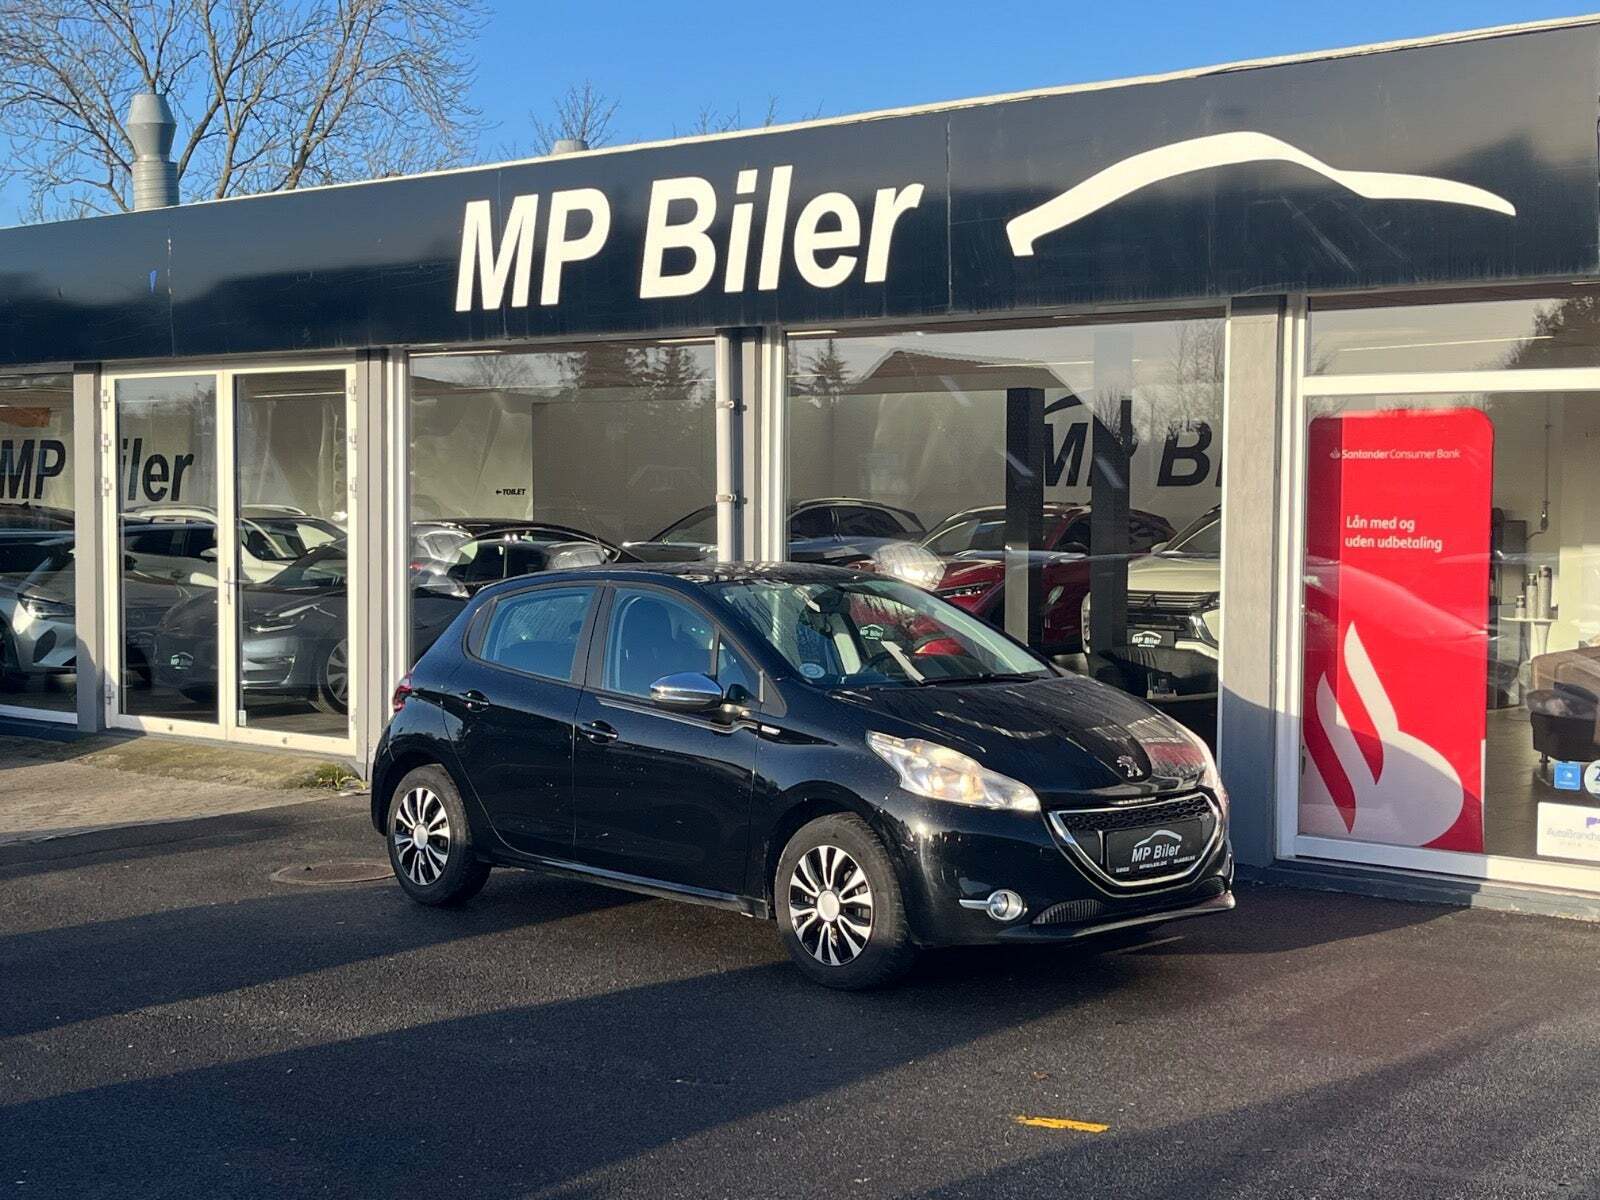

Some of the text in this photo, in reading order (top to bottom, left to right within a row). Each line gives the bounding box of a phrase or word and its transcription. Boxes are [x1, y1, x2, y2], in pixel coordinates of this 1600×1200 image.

[455, 164, 925, 312] MP Biler
[1157, 420, 1223, 487] B
[1342, 448, 1460, 459] Santander Consumer Bank
[0, 437, 195, 502] MP iler
[1346, 514, 1415, 532] Lån med og
[1345, 535, 1443, 552] uden udbetaling
[1131, 843, 1181, 863] MP Biler
